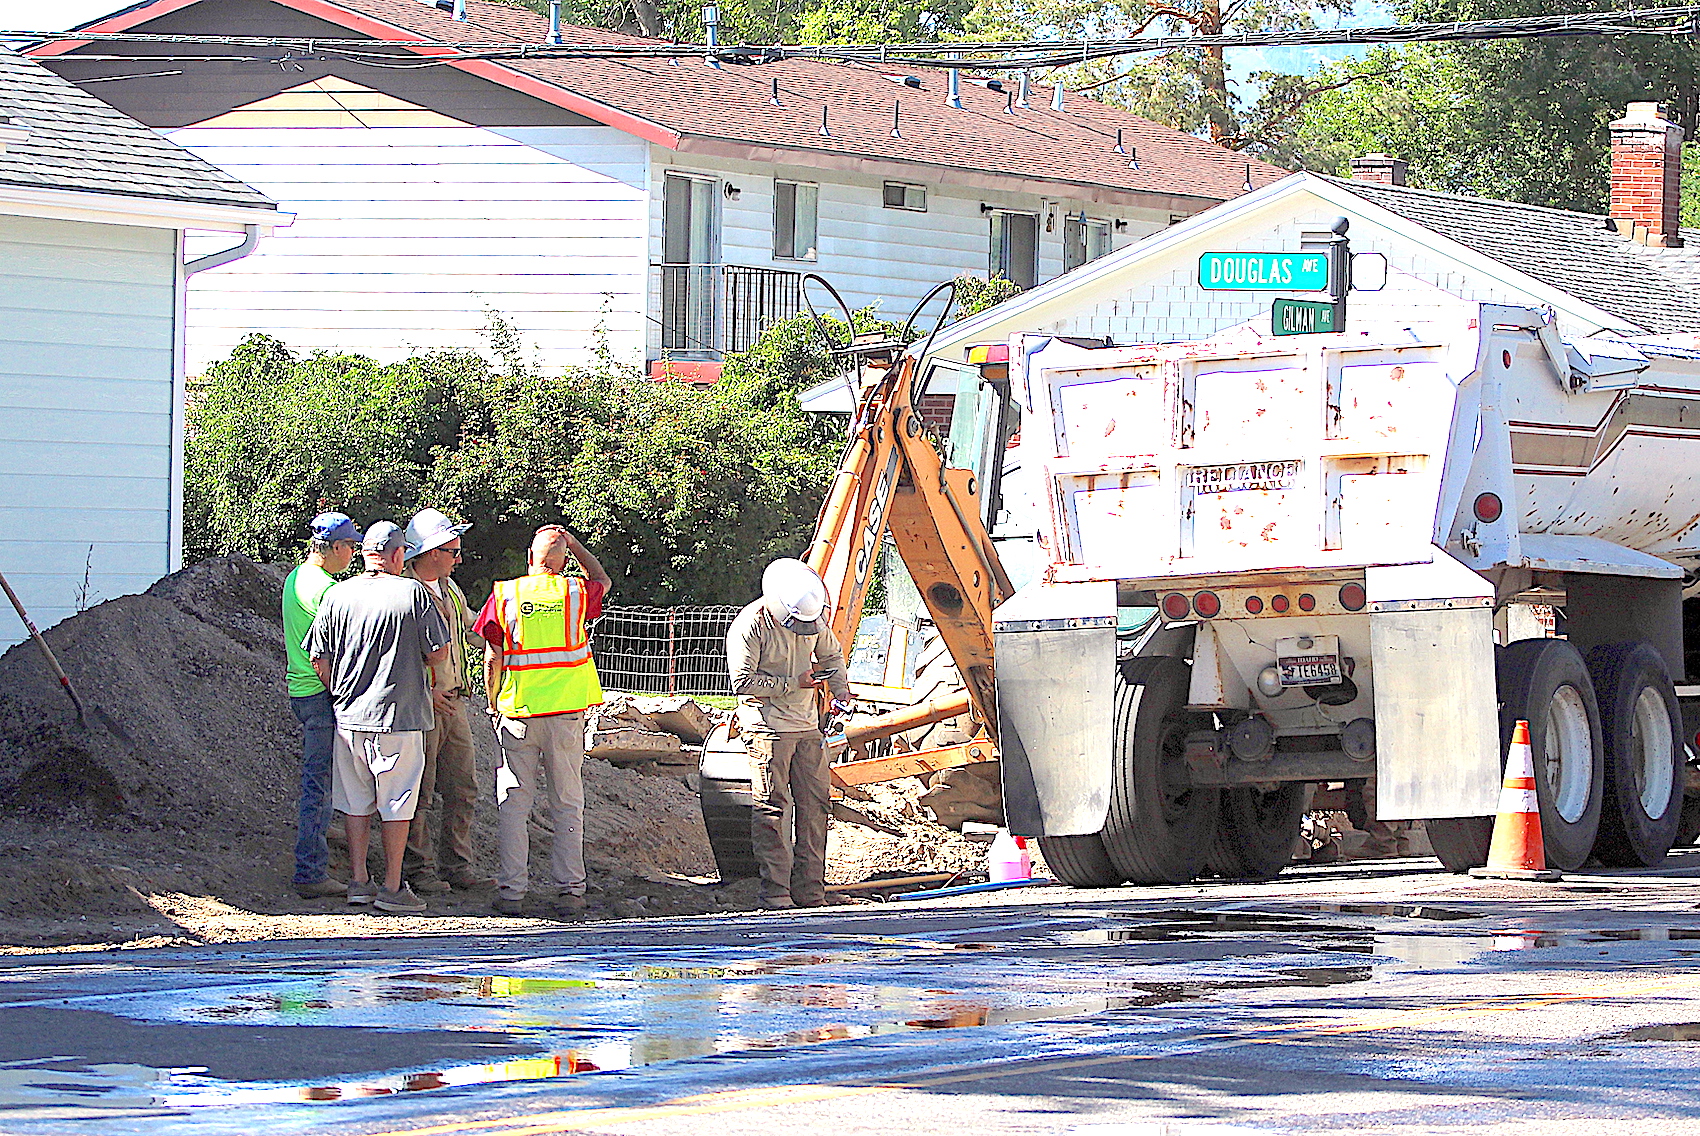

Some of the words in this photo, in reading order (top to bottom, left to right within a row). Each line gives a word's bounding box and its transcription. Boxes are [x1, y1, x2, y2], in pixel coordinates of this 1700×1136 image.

[1210, 257, 1293, 283] DOUGLAS
[1302, 258, 1319, 273] AVE
[1282, 305, 1315, 332] GILMAN
[1320, 309, 1331, 324] AVE
[855, 470, 889, 585] CASE
